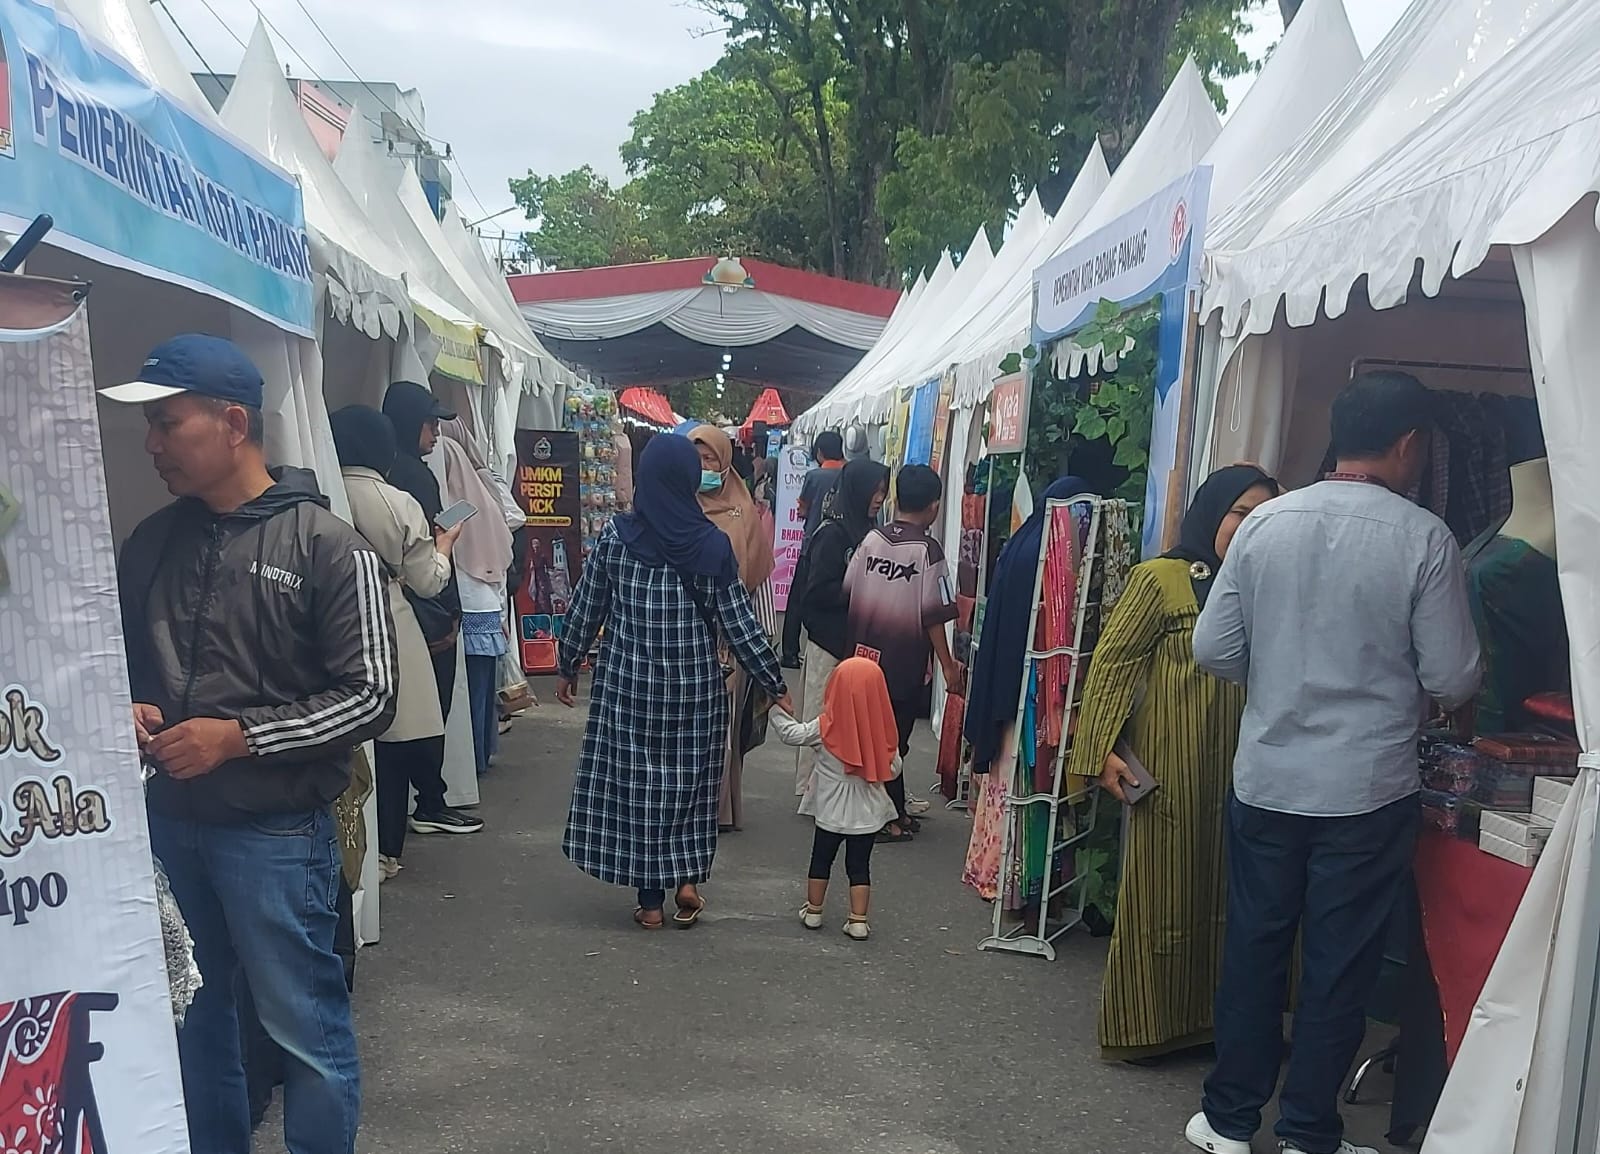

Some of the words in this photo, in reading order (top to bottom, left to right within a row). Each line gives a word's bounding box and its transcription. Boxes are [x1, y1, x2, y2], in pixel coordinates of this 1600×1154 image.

[23, 48, 202, 226] PEMERINTAH
[193, 172, 251, 254] KOTA
[1094, 245, 1118, 288] PADANG
[520, 466, 562, 482] UMKM
[520, 482, 564, 498] PERSIT
[529, 498, 554, 514] KCK
[857, 646, 880, 660] EDGE
[11, 775, 111, 847] Ala
